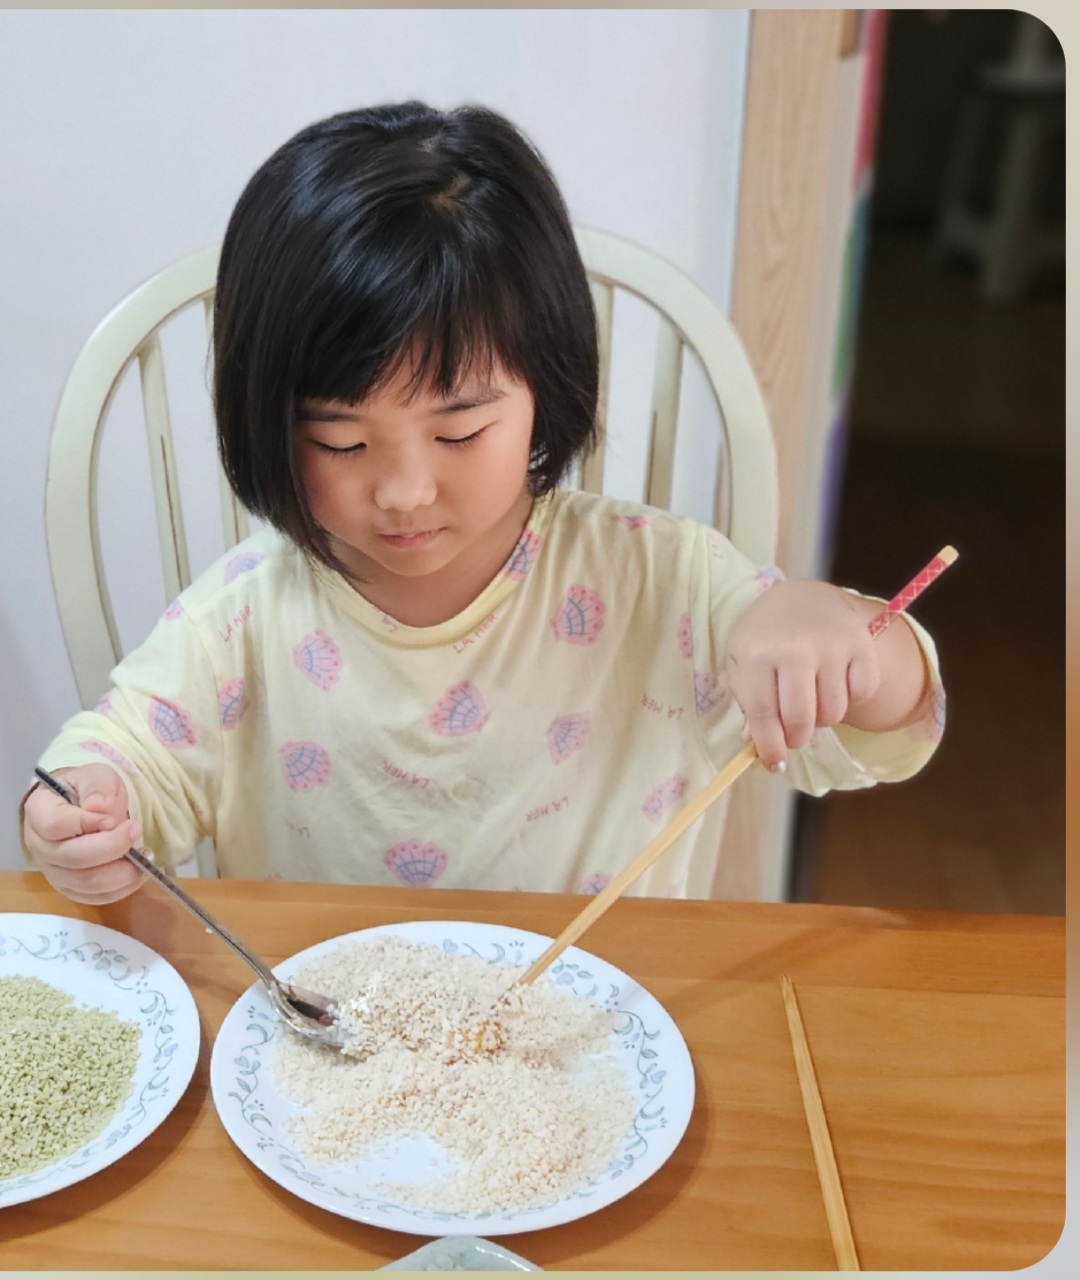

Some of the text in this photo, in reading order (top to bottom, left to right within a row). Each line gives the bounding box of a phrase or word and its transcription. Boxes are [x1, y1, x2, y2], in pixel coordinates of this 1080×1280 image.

[219, 604, 254, 643] LA MER
[452, 613, 500, 655] LA MER
[641, 692, 684, 720] LA MER
[383, 760, 431, 790] LA MER
[526, 796, 569, 822] LA MER
